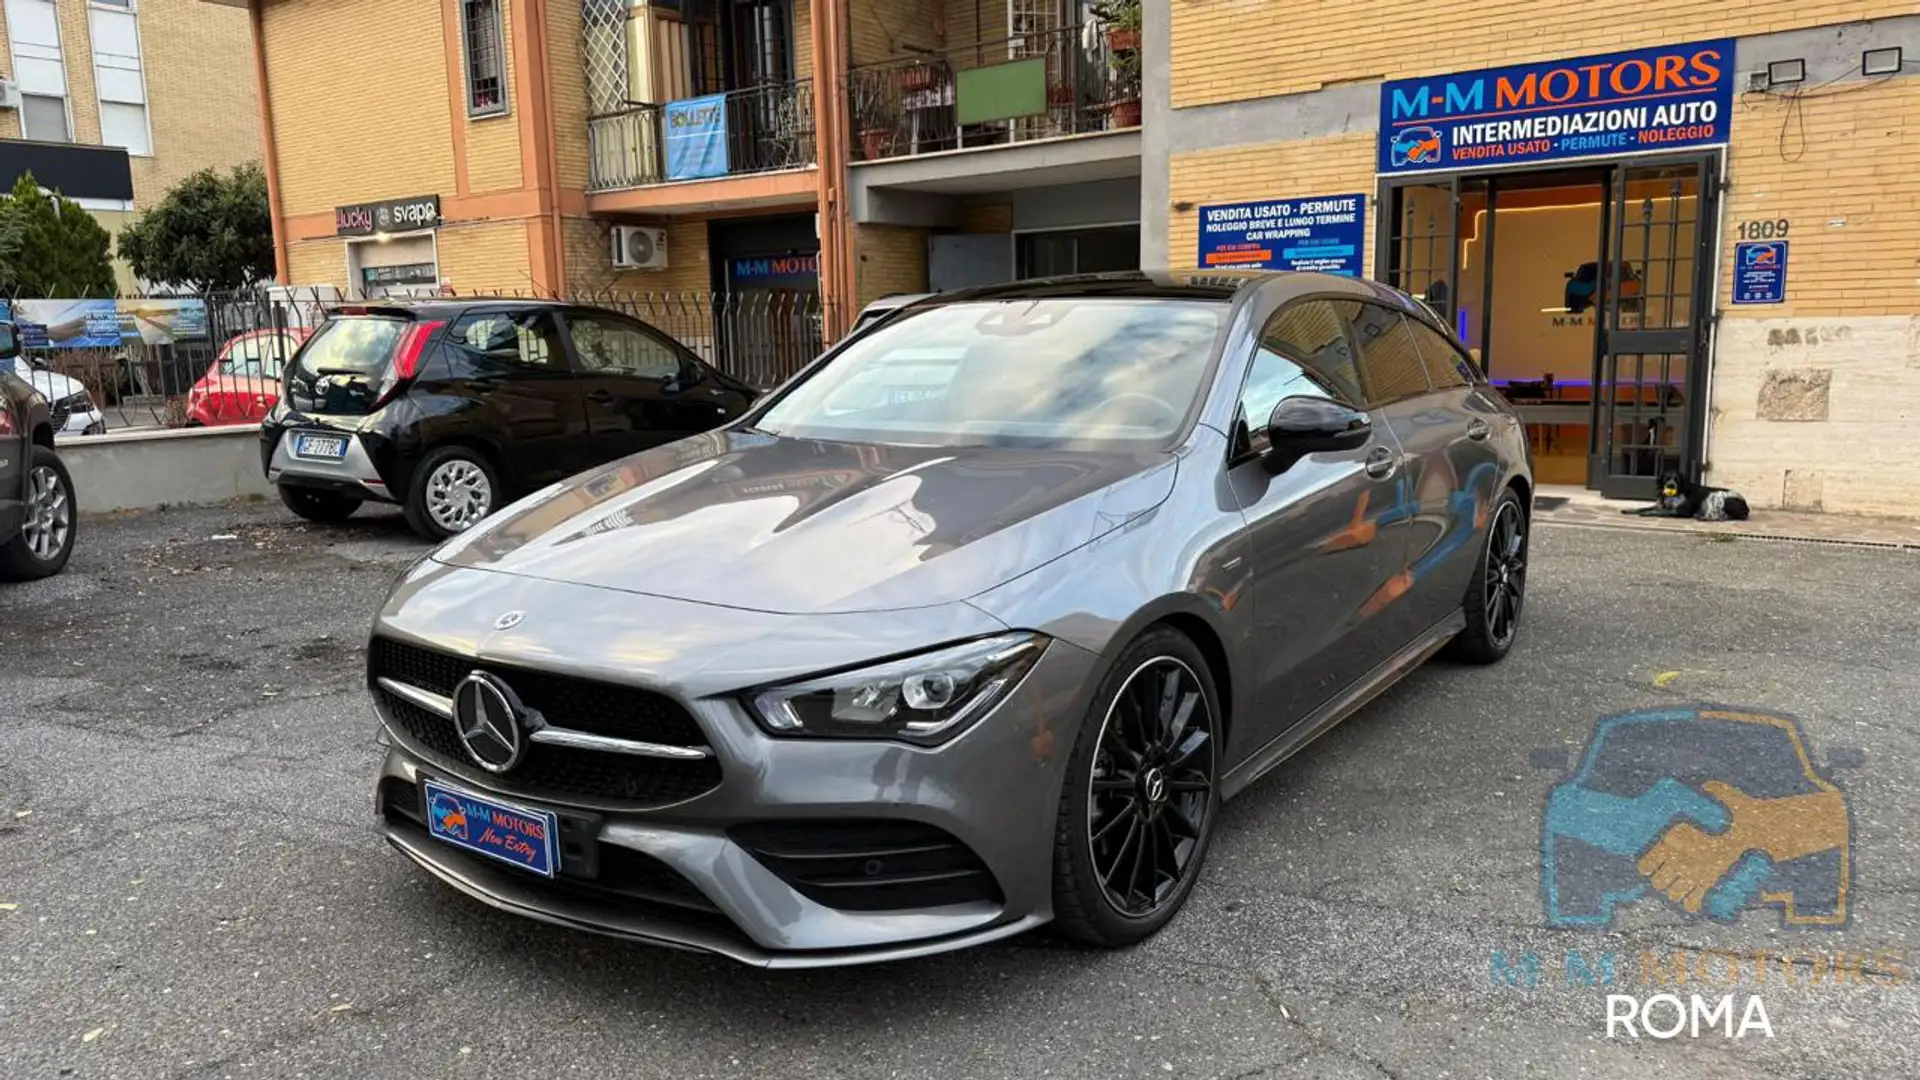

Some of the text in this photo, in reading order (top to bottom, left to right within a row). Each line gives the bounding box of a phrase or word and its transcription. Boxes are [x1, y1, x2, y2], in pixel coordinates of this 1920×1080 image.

[1392, 50, 1721, 119] M-M MOTORS
[1452, 100, 1718, 146] INTERMEDIAZIONI AUTO
[1452, 144, 1505, 160] VENDITA
[1507, 140, 1551, 156] USATO
[1561, 133, 1627, 151] PERMUTE
[1638, 124, 1715, 144] NOLEGGIO
[394, 202, 437, 226] svapo
[1207, 207, 1252, 222] VENDITA
[1254, 204, 1291, 219] USATO
[1300, 198, 1356, 215] PERMUTE
[1206, 213, 1356, 233] NOLEGGIO BREVE E LUNGO TERMINE
[1246, 228, 1311, 241] CAR WRAPPING
[1738, 219, 1789, 240] 1809
[736, 260, 768, 276] M-M
[465, 803, 545, 840] M-M MOTORS
[479, 827, 537, 864] New Entry
